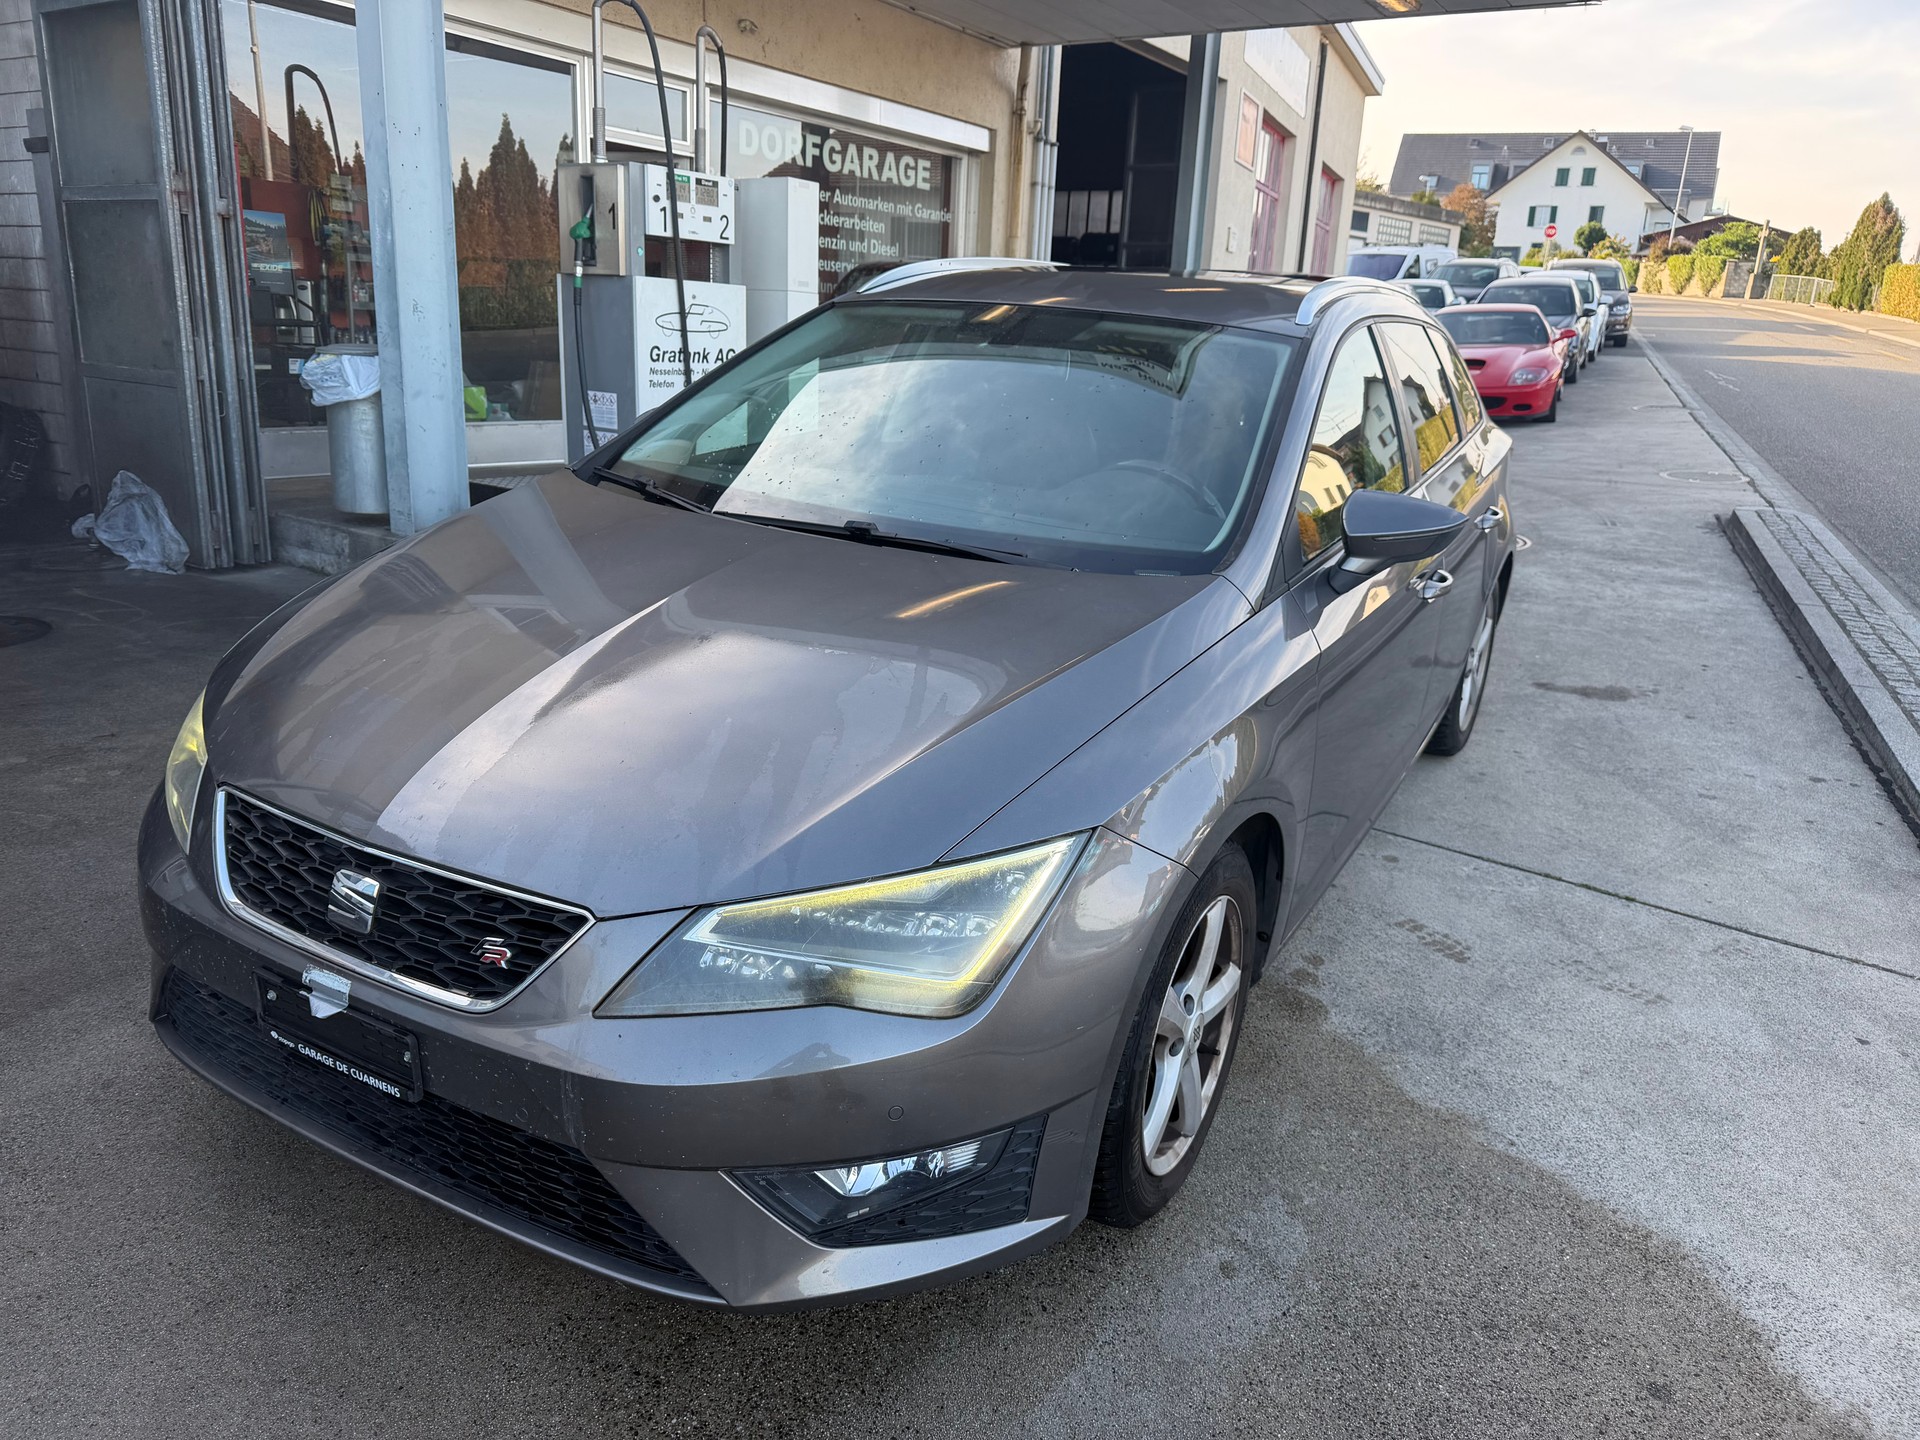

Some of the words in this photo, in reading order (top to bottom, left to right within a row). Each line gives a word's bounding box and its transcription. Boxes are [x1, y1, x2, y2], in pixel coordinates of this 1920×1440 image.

[738, 119, 932, 191] DORFGARAGE
[608, 202, 616, 230] 1
[833, 188, 894, 214] Automarken
[896, 202, 912, 217] mit
[914, 203, 952, 222] Garantie
[659, 206, 667, 233] 1
[719, 214, 730, 241] 2
[819, 209, 885, 234] ckierarbeiten
[819, 235, 846, 251] enzin
[849, 237, 868, 253] und
[870, 239, 900, 257] Diesel
[649, 345, 710, 364] Gratnk
[648, 379, 675, 389] Telefon
[649, 367, 695, 376] Nesselnbah
[297, 1043, 335, 1068] GARAGE
[336, 1060, 349, 1075] DE
[350, 1067, 401, 1098] CUARNENS
